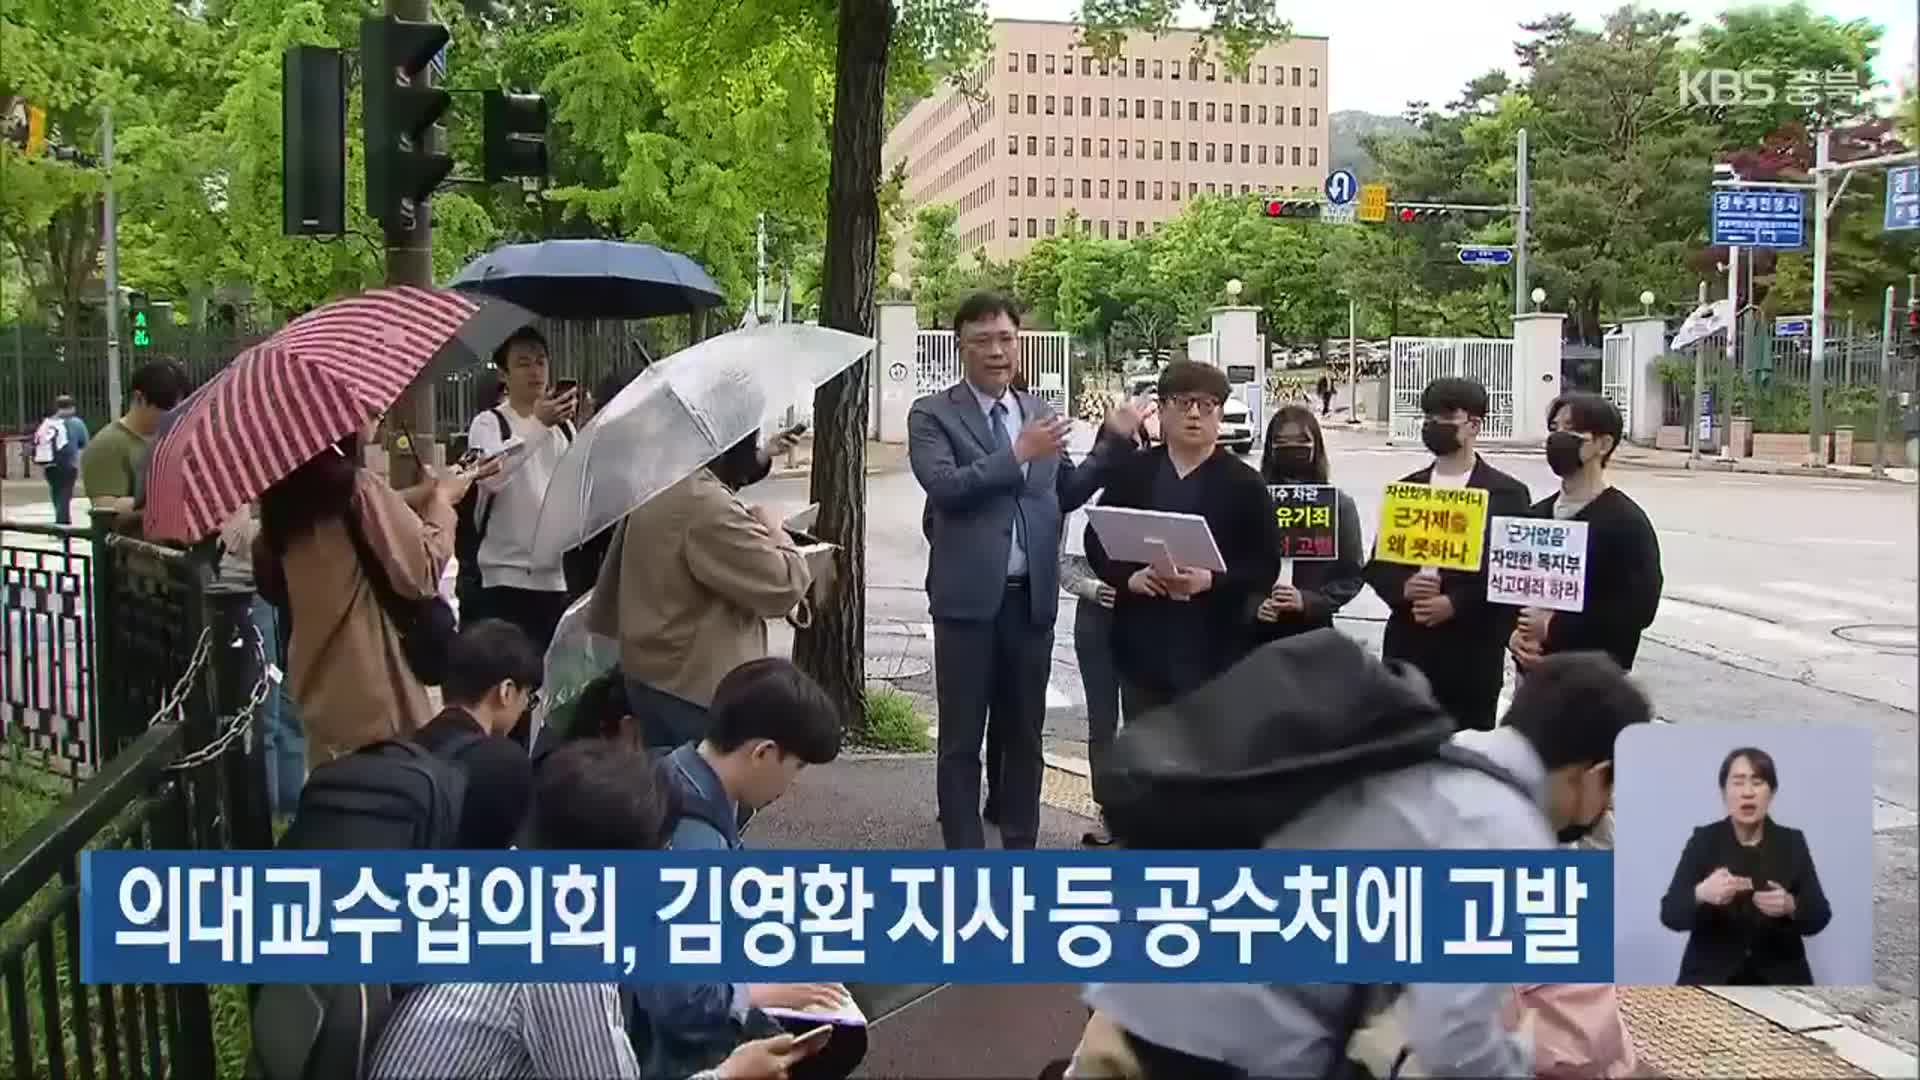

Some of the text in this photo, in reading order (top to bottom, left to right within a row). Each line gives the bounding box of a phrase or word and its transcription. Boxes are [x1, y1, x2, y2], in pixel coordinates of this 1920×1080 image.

[1276, 506, 1330, 527] 유기죄
[1387, 534, 1469, 564] 왜 못하나
[1537, 553, 1580, 575] 복지부
[1550, 580, 1578, 601] 하라
